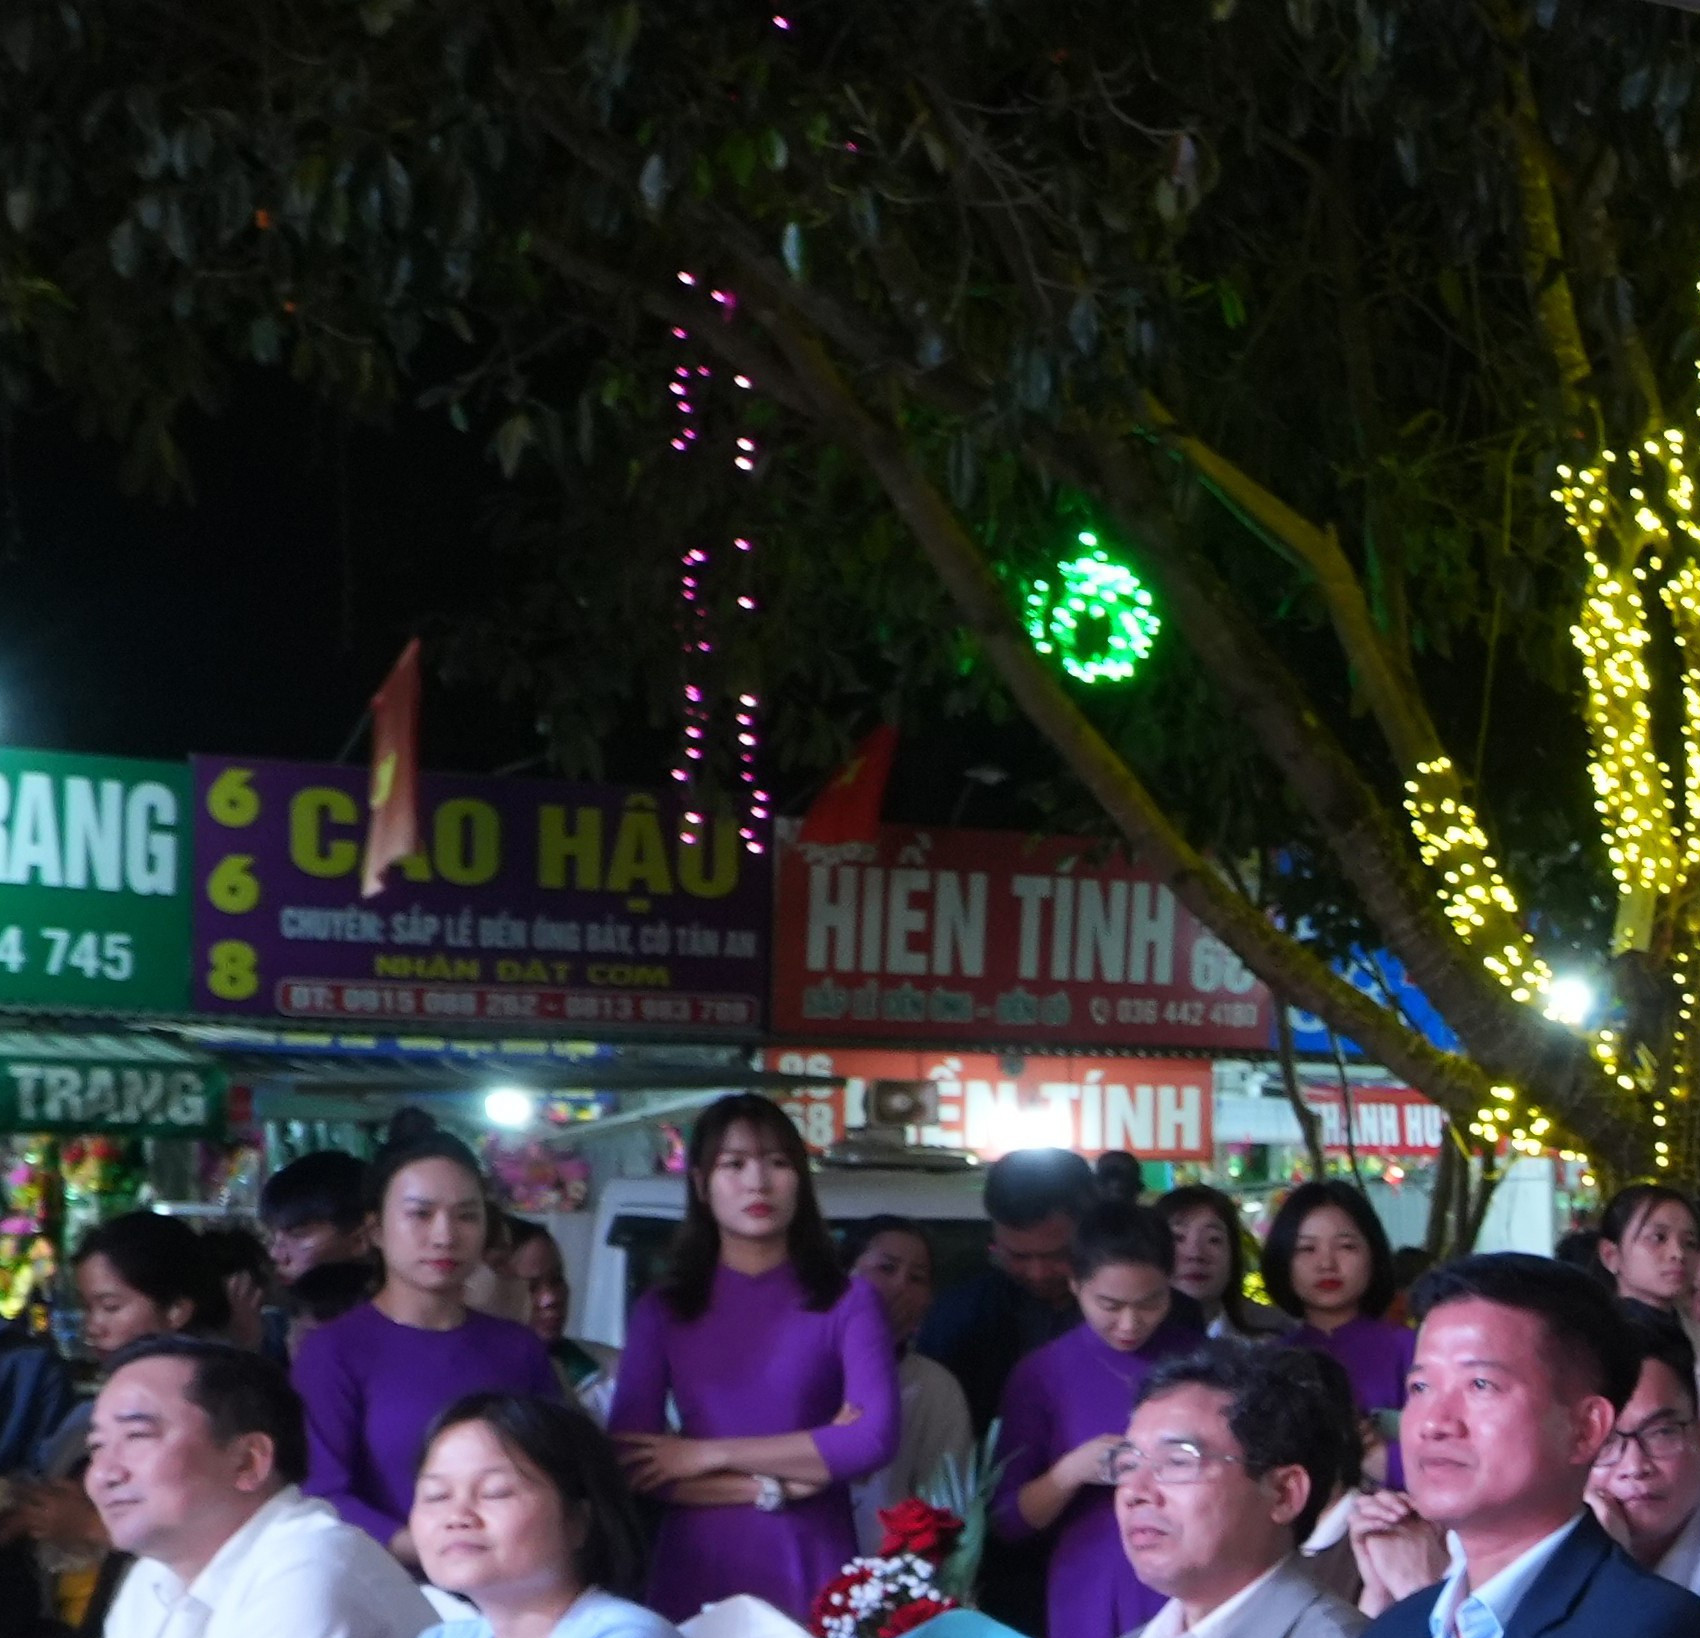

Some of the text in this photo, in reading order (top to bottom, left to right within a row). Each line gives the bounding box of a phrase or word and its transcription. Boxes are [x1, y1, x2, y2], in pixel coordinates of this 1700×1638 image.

[0, 770, 178, 896] ANG
[290, 786, 742, 914] CO HẬU
[41, 928, 133, 982] 745
[1011, 853, 1174, 987] TÍNH
[6, 1062, 207, 1126] TRANG
